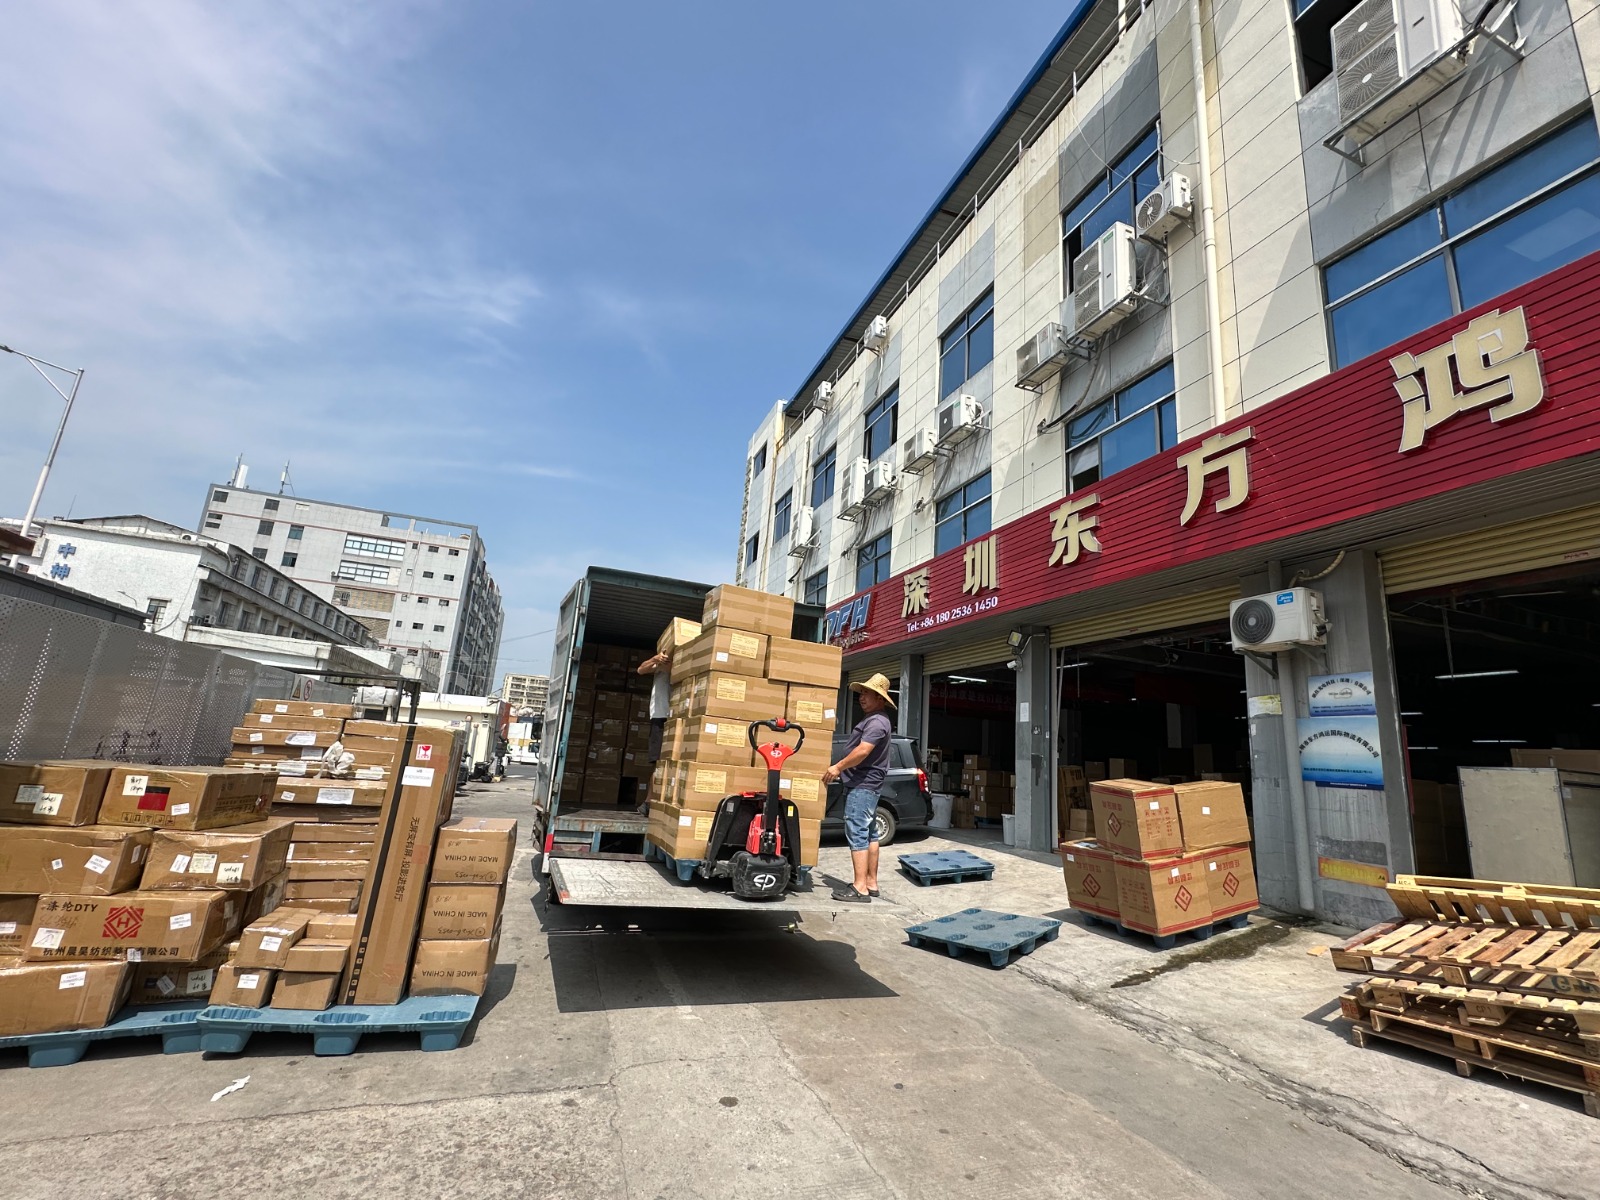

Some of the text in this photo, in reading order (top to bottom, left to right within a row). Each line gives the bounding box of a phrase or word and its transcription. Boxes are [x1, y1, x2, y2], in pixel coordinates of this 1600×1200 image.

[906, 596, 999, 633] Tel: +86 180 2536 1450
[1298, 729, 1380, 758] 圳市东方鸿运国际物流有限公司
[444, 854, 468, 862] CHINA
[478, 855, 499, 863] MADE
[433, 910, 456, 918] CHINA
[422, 969, 445, 977] CHINA
